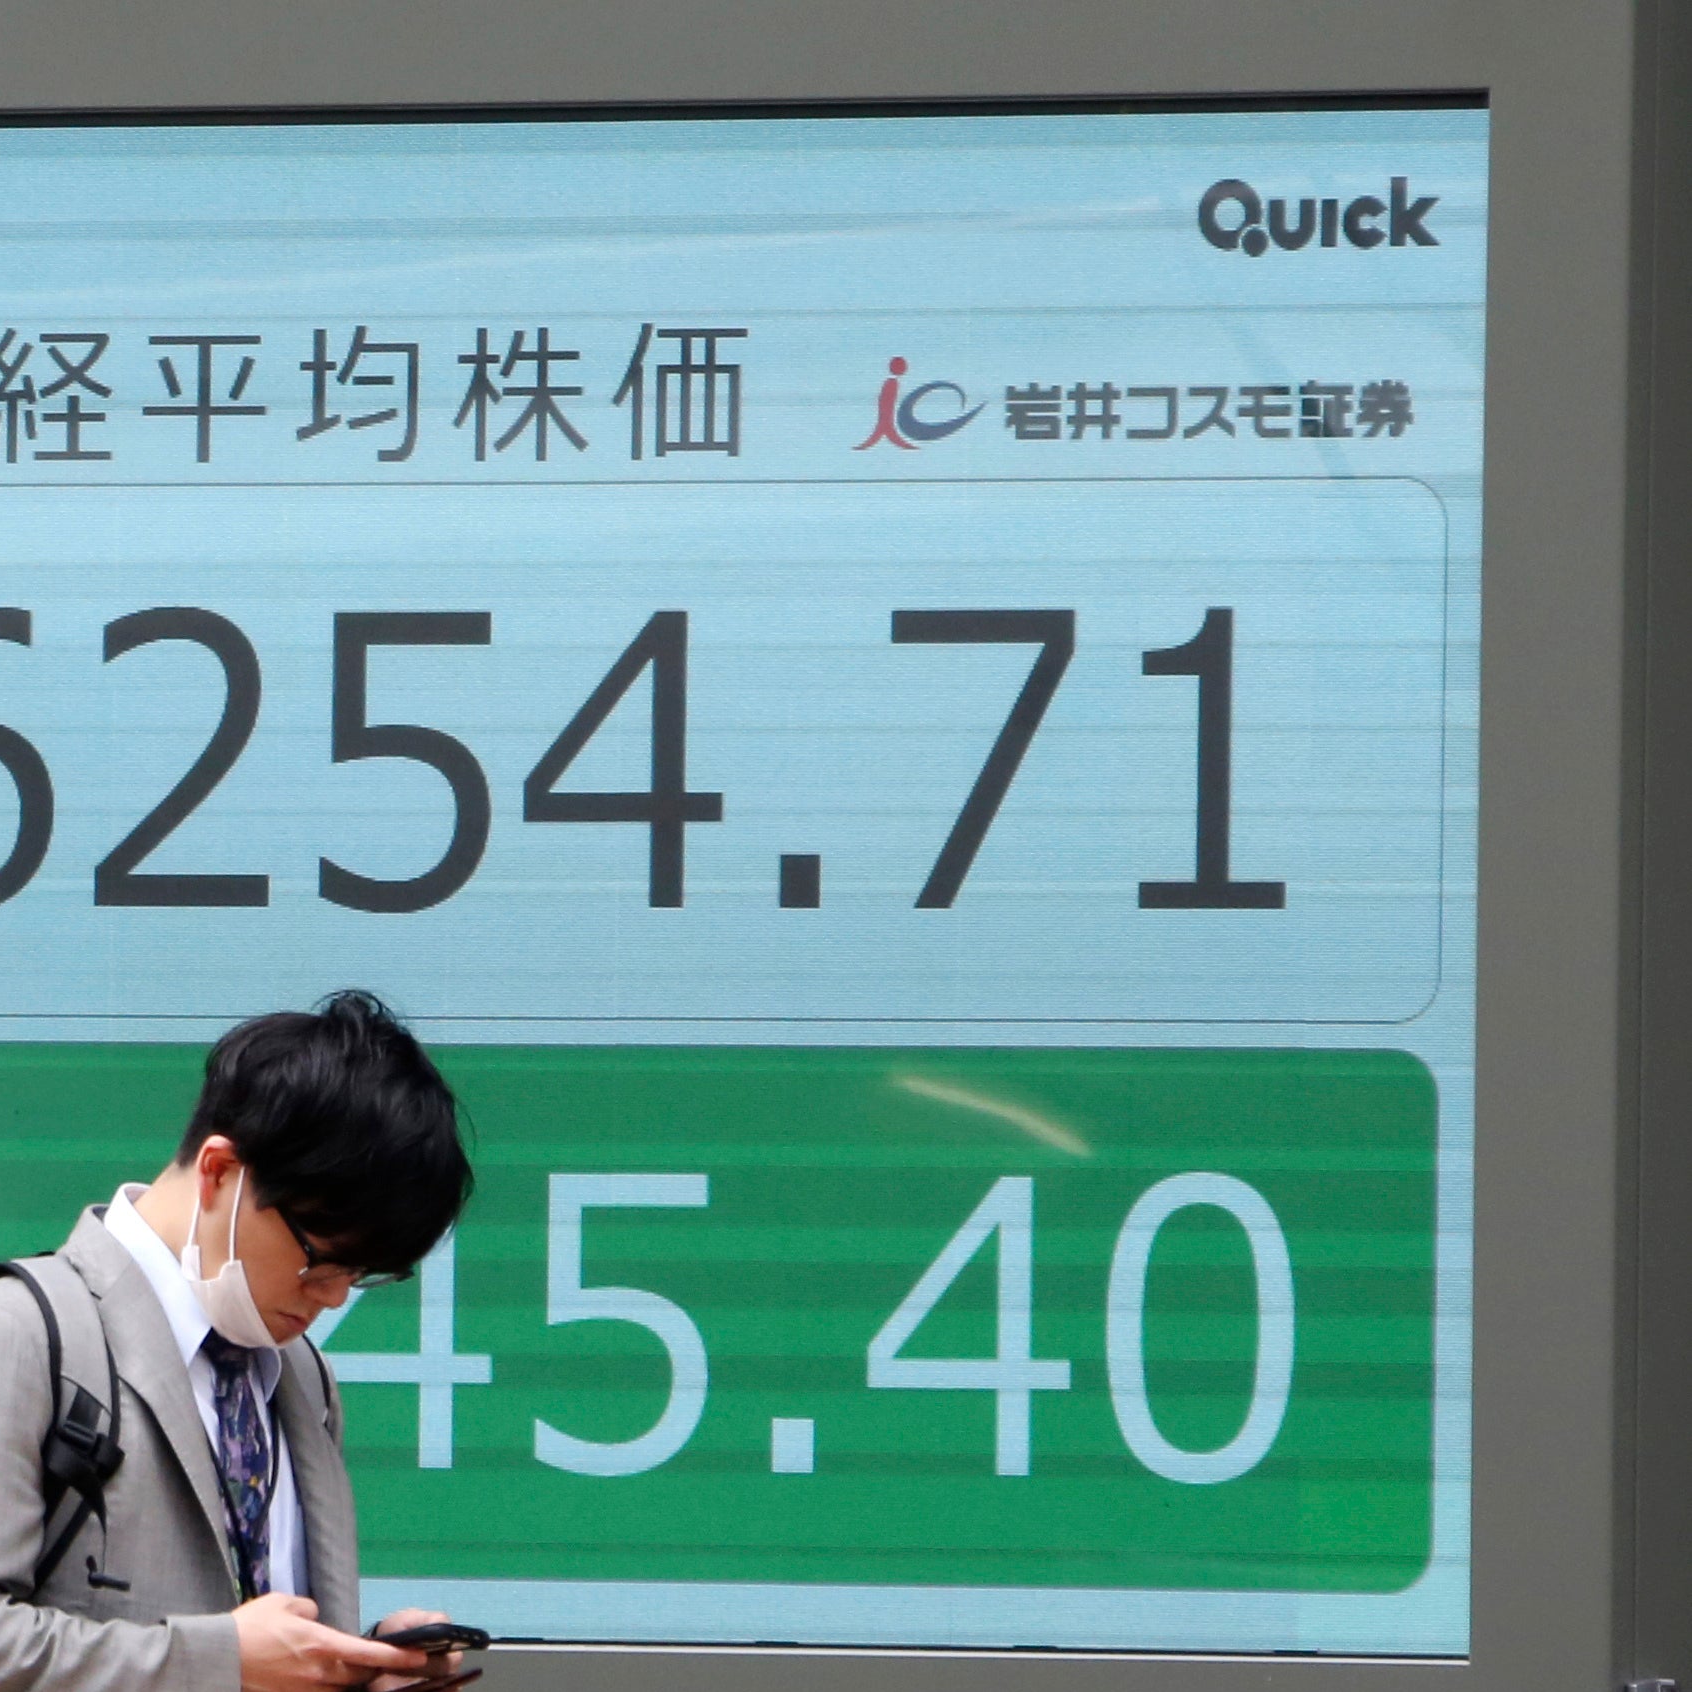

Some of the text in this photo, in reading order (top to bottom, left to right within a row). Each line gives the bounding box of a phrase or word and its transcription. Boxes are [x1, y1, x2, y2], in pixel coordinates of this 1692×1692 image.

[1005, 380, 1415, 442] 岩井コスモ証券
